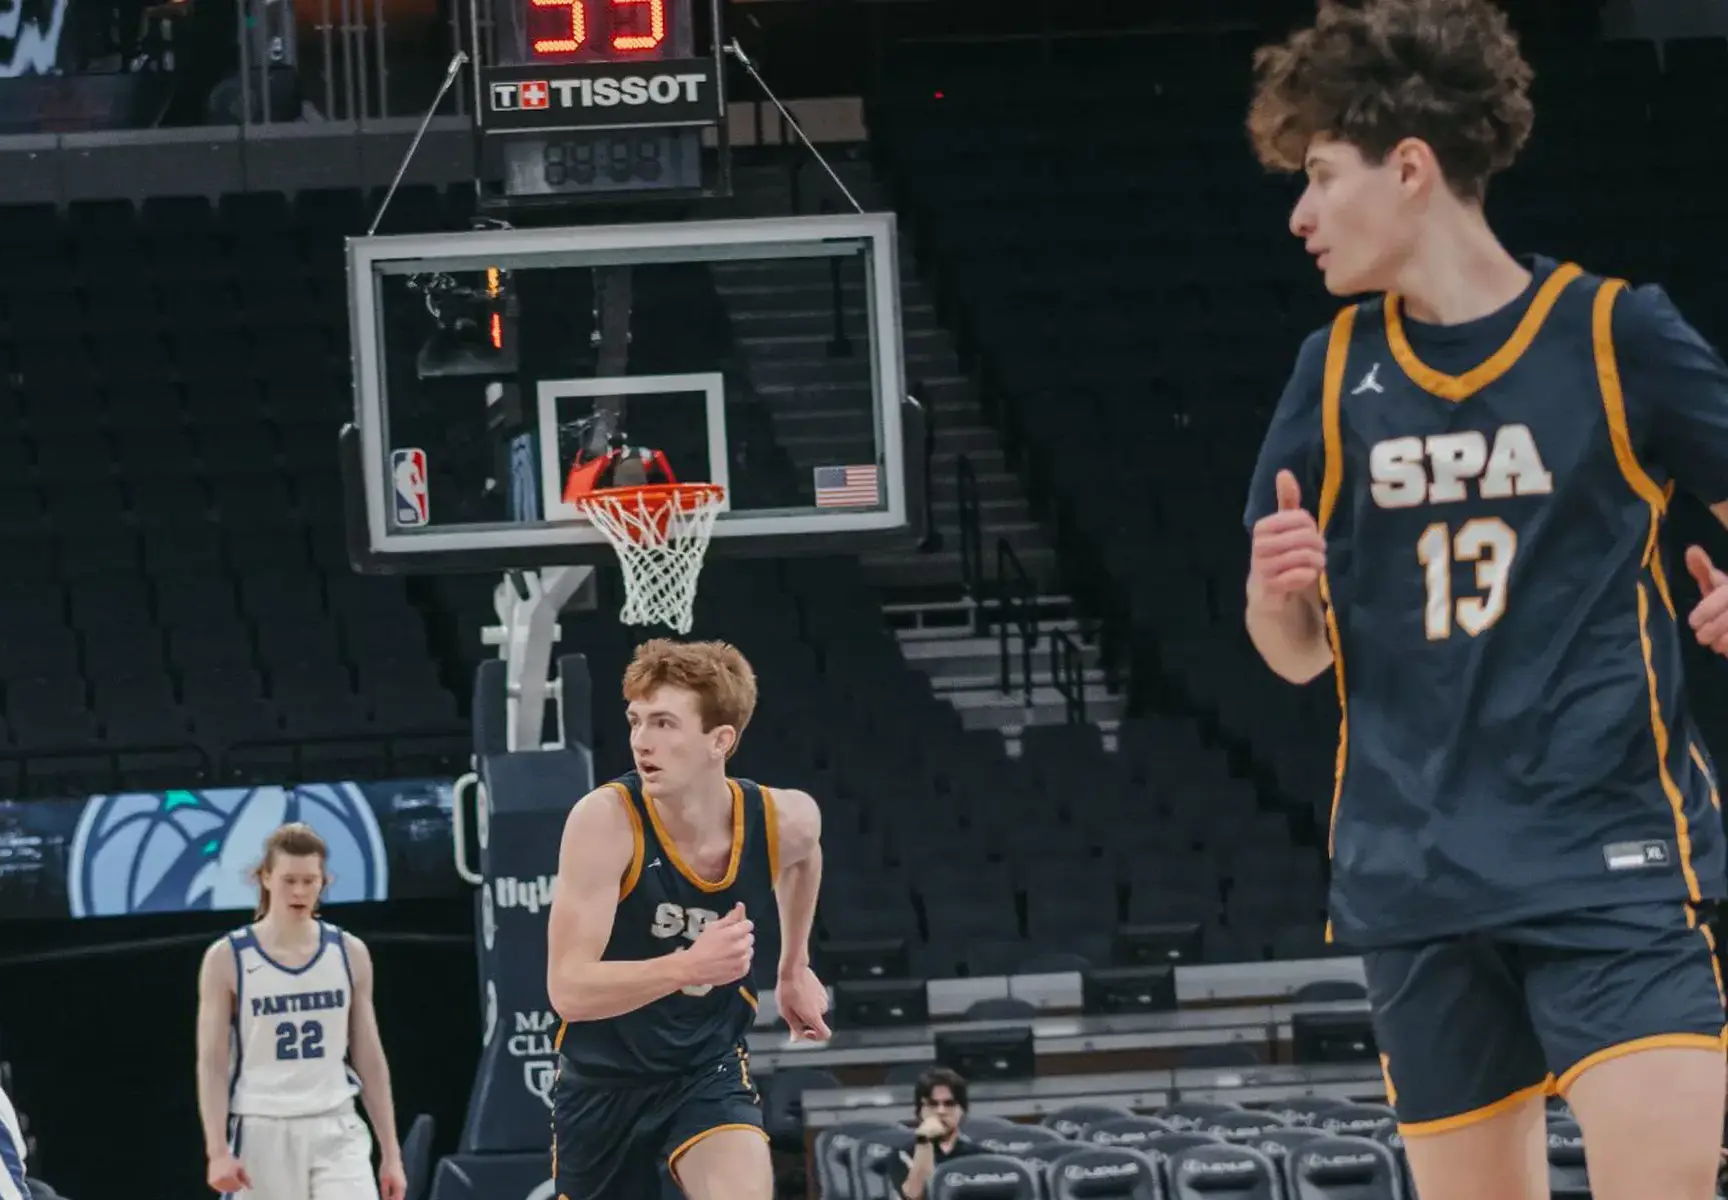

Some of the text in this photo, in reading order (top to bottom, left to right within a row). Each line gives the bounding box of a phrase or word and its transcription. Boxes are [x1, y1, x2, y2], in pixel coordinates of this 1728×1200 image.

[549, 74, 707, 107] TISSOT
[1369, 423, 1554, 509] SPA
[1417, 516, 1518, 640] 13
[651, 903, 720, 941] SP
[251, 988, 344, 1017] PANTHERS
[514, 1011, 556, 1032] MA
[275, 1020, 325, 1060] 22
